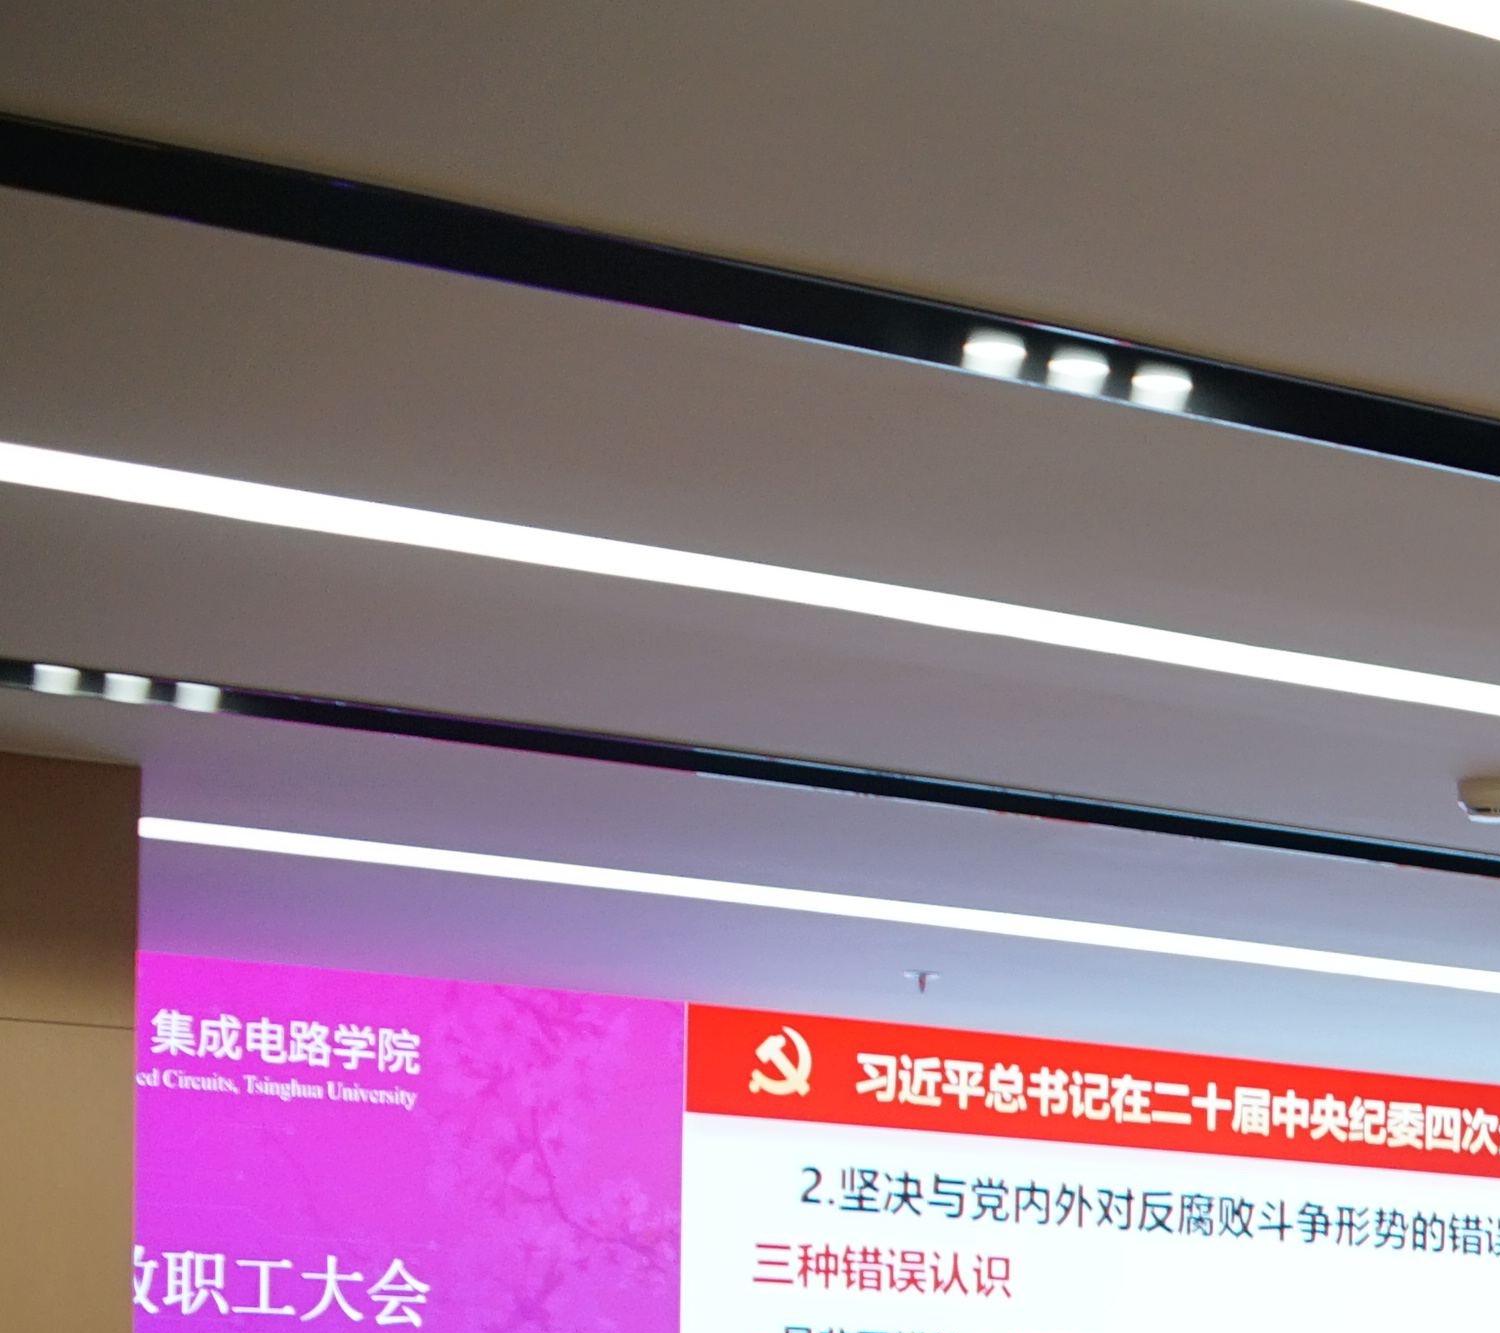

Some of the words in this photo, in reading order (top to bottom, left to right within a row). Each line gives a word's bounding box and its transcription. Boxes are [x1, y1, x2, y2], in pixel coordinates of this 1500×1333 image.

[150, 1008, 421, 1075] 集成电路学院
[162, 1069, 240, 1095] Circuits,
[243, 1074, 323, 1102] Tsinghua
[326, 1080, 417, 1111] University
[752, 1242, 1013, 1300] 三种错误认识
